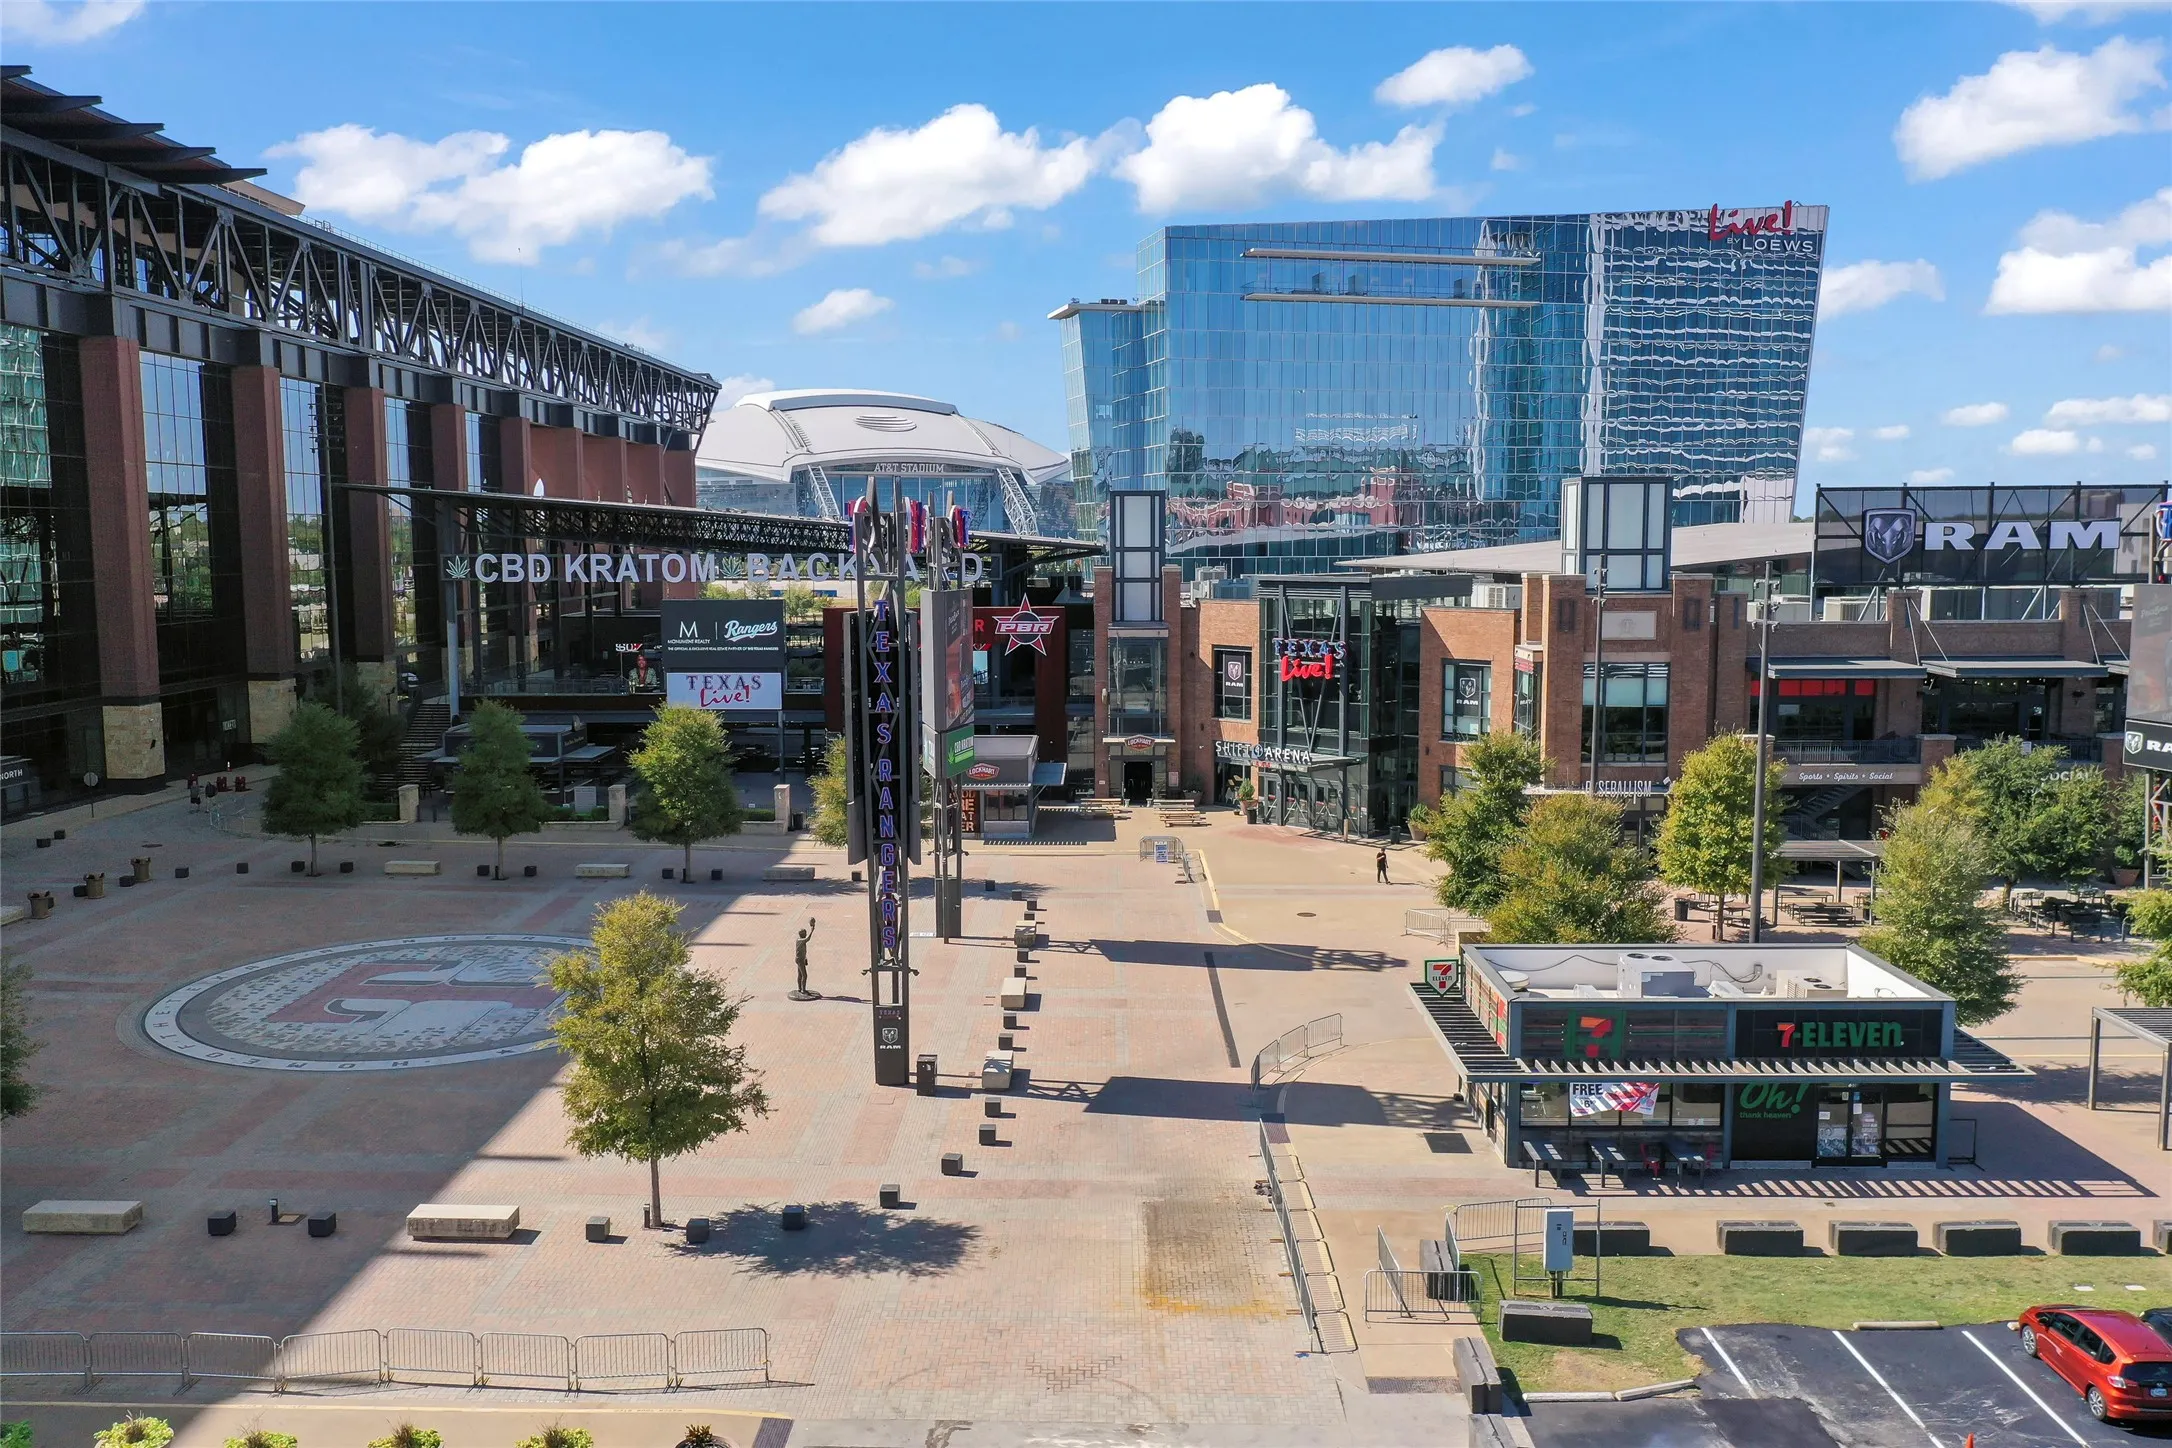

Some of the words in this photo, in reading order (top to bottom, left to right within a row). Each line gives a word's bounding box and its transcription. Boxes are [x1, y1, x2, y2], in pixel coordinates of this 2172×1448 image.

[1709, 200, 1792, 241] Live!
[1727, 237, 1741, 245] BY
[1742, 238, 1814, 252] LOEWS
[874, 463, 898, 473] AT&T
[900, 463, 944, 473] STADIUM
[1924, 521, 2121, 550] RAM
[475, 553, 551, 583] CBD
[565, 553, 716, 583] KRATOM
[747, 553, 982, 583] BACKAD
[679, 621, 699, 638] M
[724, 620, 778, 642] Rangers
[999, 622, 1051, 633] PBR
[1272, 638, 1347, 659] TEXAS
[873, 600, 893, 744] TEXAS
[1281, 654, 1333, 682] Live!
[686, 675, 762, 690] TEXAS
[700, 684, 750, 707] Live!
[1215, 741, 1251, 755] SHIFT
[1265, 747, 1310, 762] ARENA
[2146, 740, 2172, 754] RA
[970, 766, 994, 774] LOCKHART
[1798, 773, 1823, 782] Sports
[1834, 773, 1858, 782] Spirits
[1869, 772, 1893, 780] Social
[1586, 781, 1652, 804] BSEBALLISM
[878, 758, 896, 950] RANGERS
[1572, 1084, 1604, 1096] FREE
[1740, 1080, 1811, 1114] Oh!
